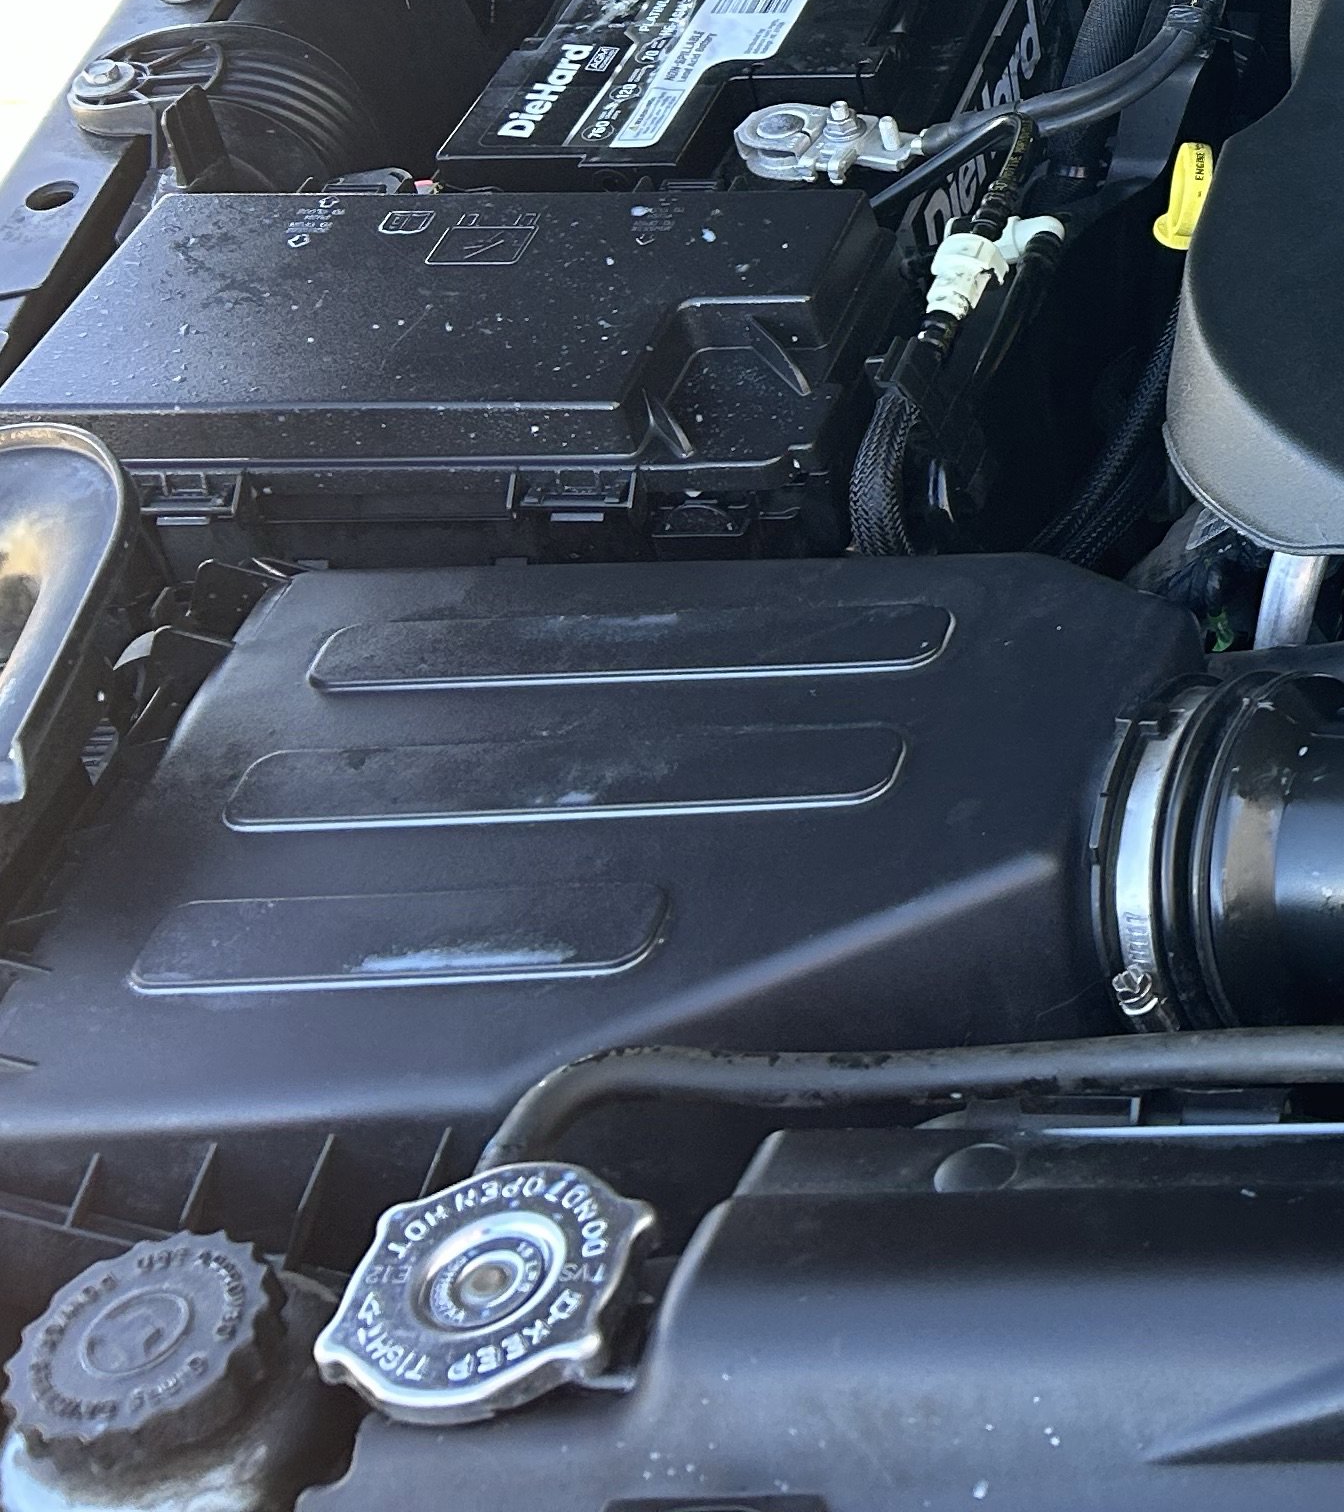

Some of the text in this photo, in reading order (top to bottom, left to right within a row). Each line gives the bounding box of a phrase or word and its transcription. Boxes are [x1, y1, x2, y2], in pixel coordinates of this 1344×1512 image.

[664, 30, 704, 81] NON-SPILLABLE
[676, 32, 719, 81] Lead Acid Battery
[497, 44, 594, 138] DieHard
[588, 119, 610, 139] 760
[617, 83, 637, 100] 120
[455, 1175, 545, 1212] OPEN
[387, 1204, 449, 1260] HOT
[357, 1318, 551, 1382] KEEP TIGHT
